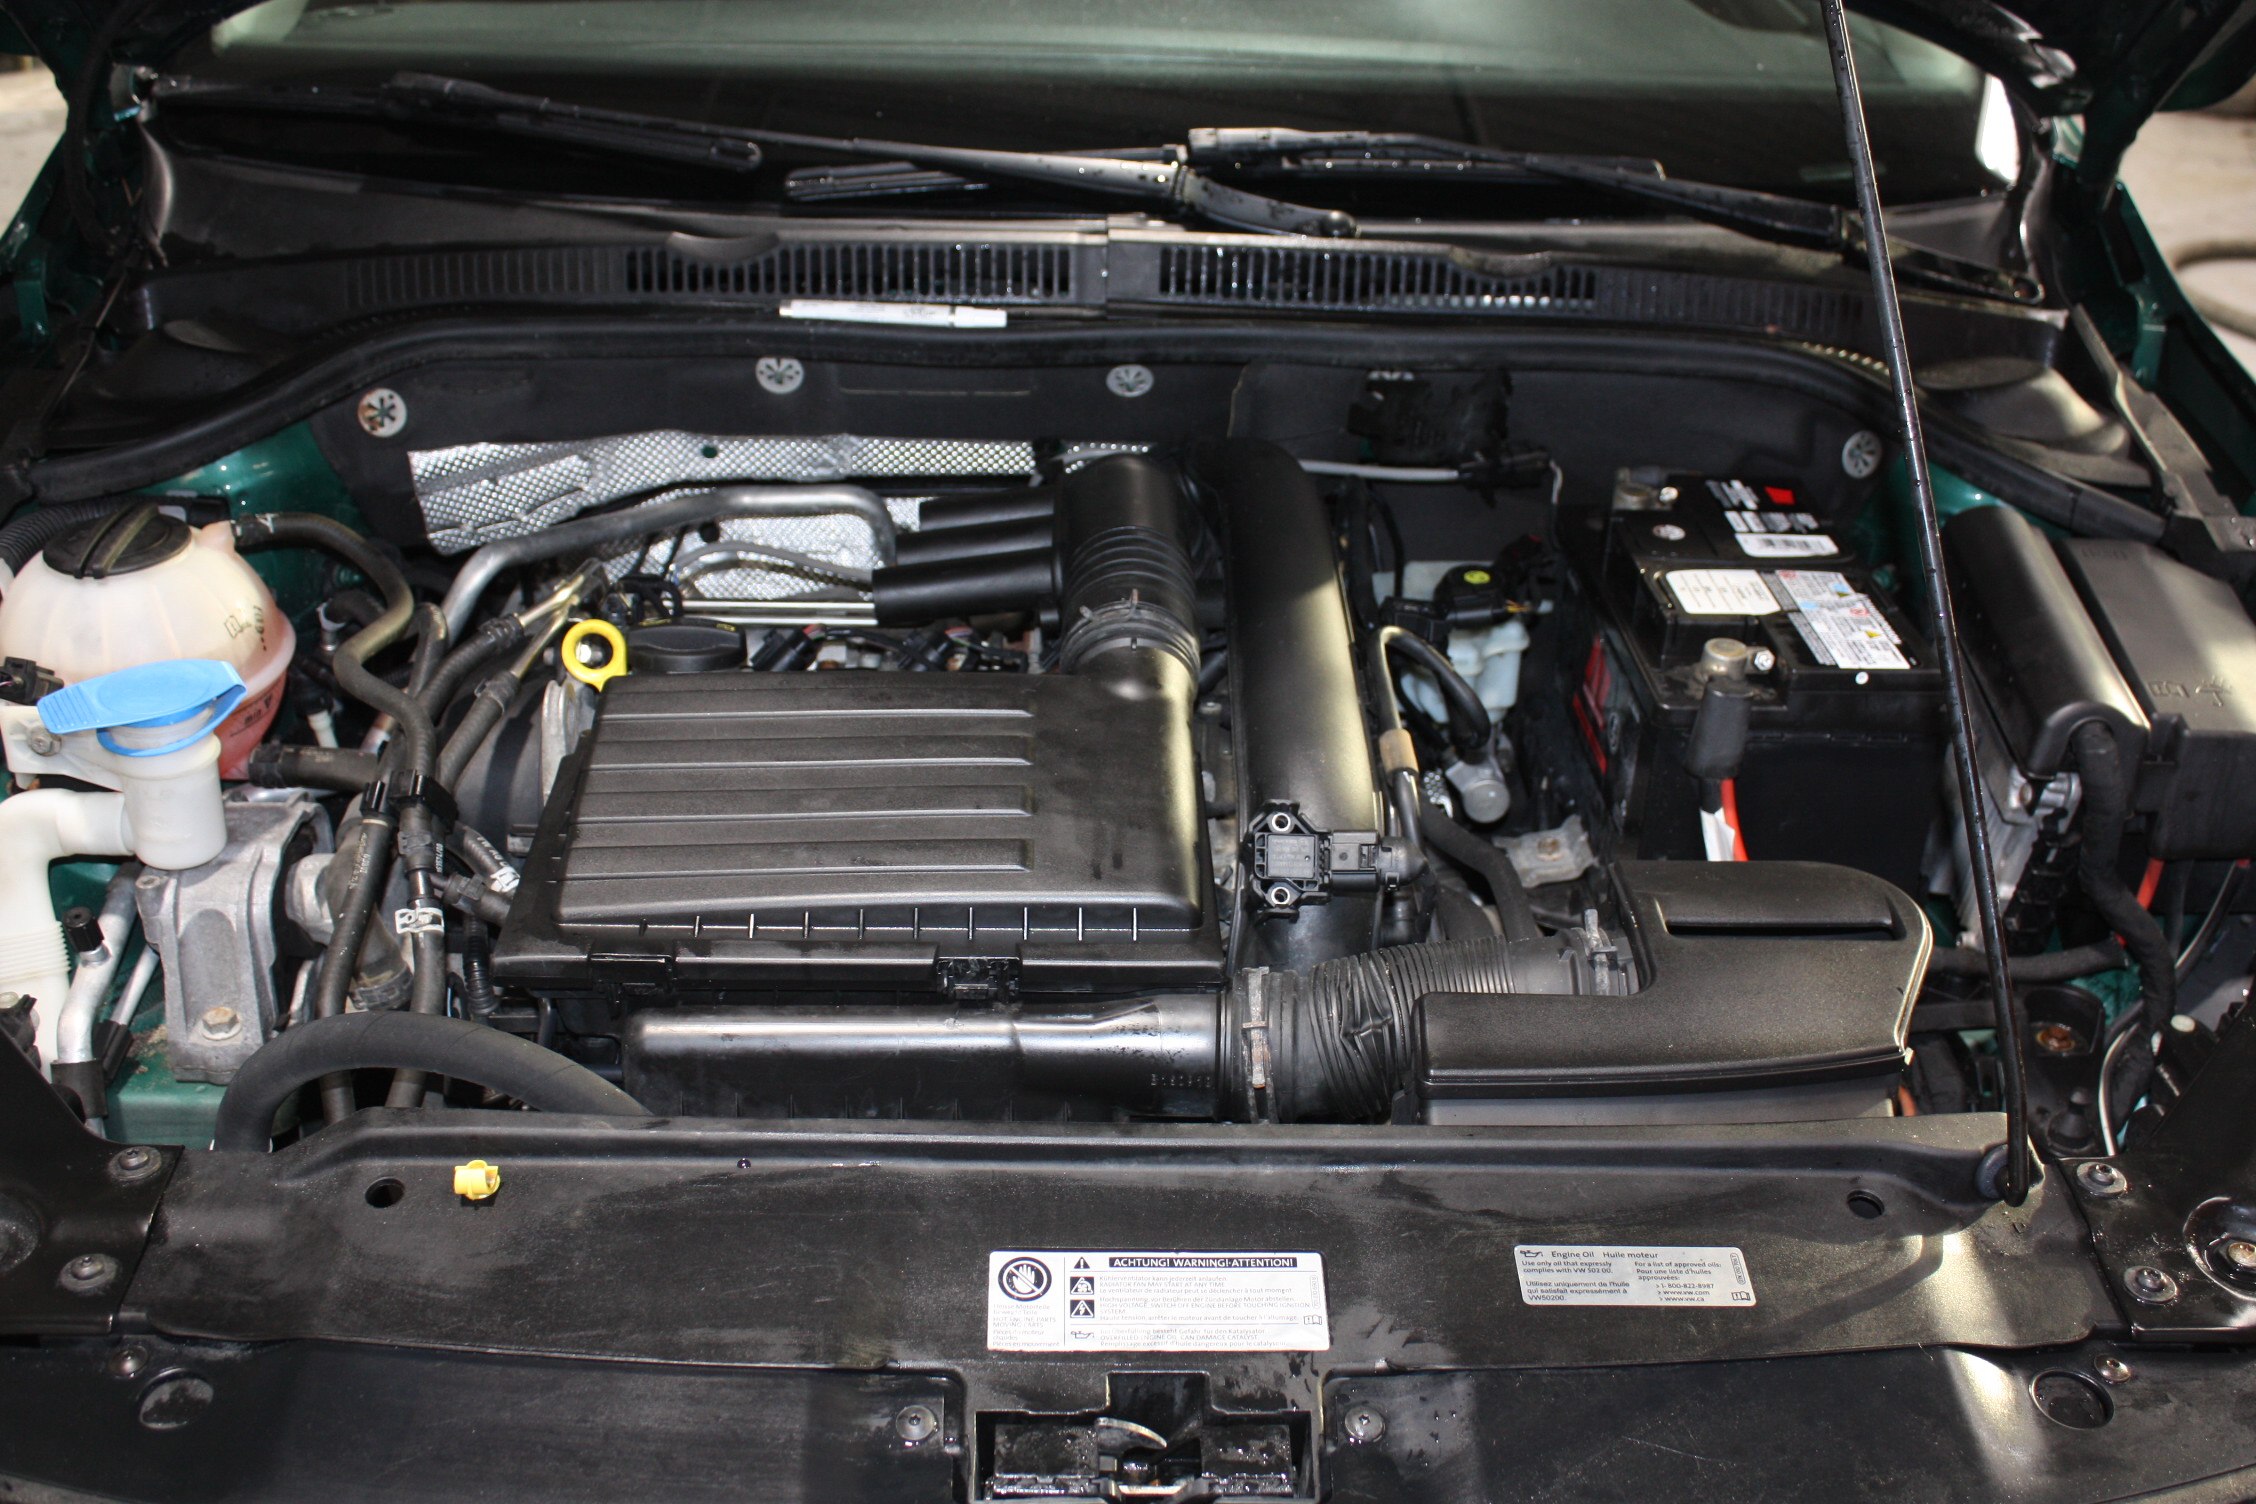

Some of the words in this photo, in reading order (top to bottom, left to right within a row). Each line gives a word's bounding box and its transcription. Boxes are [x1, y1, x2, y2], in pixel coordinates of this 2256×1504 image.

[1551, 1250, 1580, 1259] Engine
[1582, 1250, 1594, 1258] Oil
[1114, 1258, 1169, 1267] ACHTUNG!
[1174, 1258, 1228, 1267] WARNING!
[1232, 1258, 1293, 1267] ATTENTION!
[1580, 1260, 1612, 1268] expressly
[1674, 1261, 1706, 1269] approved
